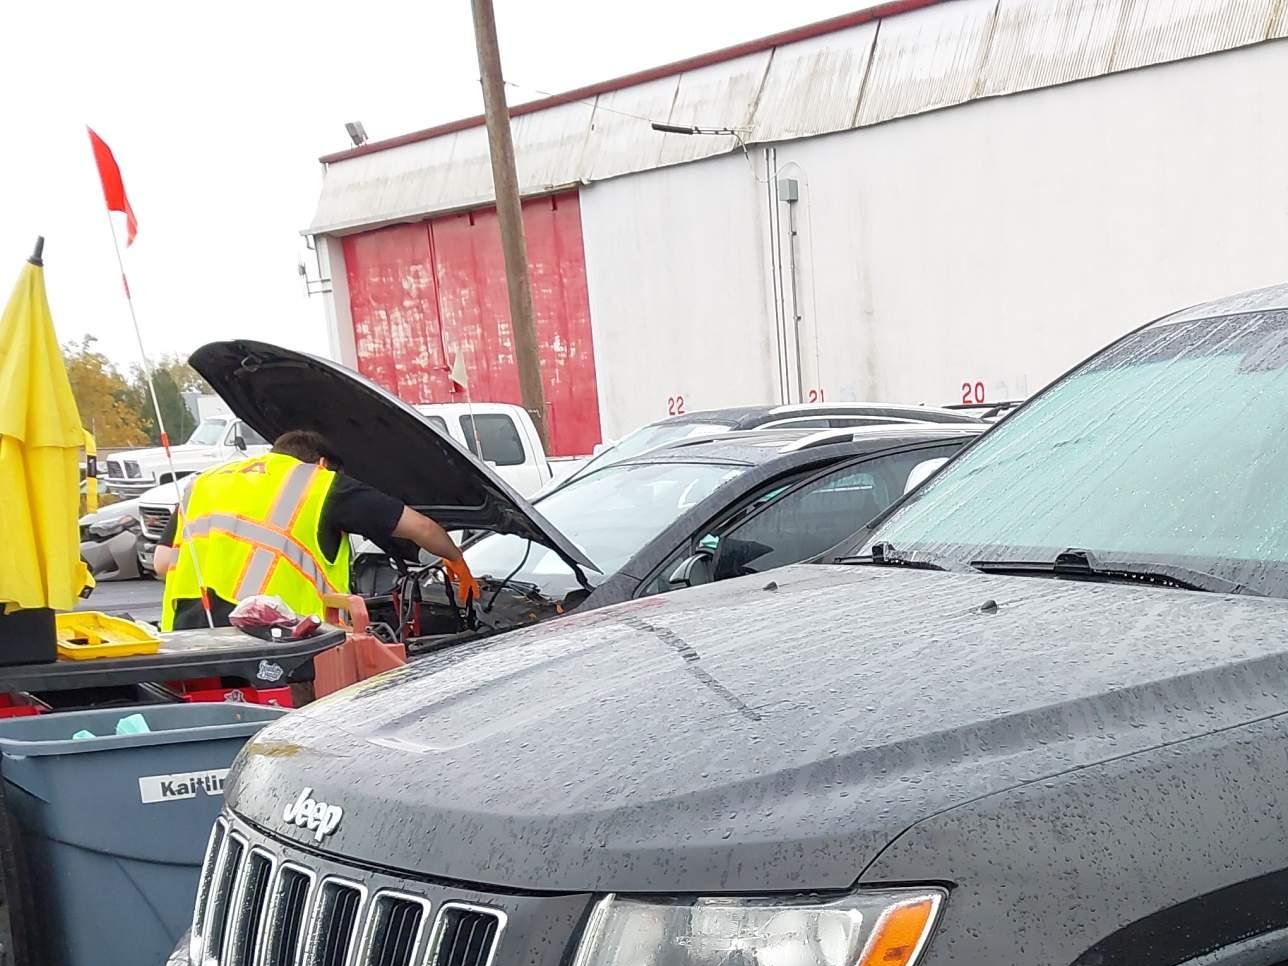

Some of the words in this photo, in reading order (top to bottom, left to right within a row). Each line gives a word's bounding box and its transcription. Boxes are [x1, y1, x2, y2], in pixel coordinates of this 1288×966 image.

[808, 388, 825, 404] 21
[962, 381, 985, 404] 20
[667, 395, 686, 416] 22
[283, 786, 343, 842] Jeep
